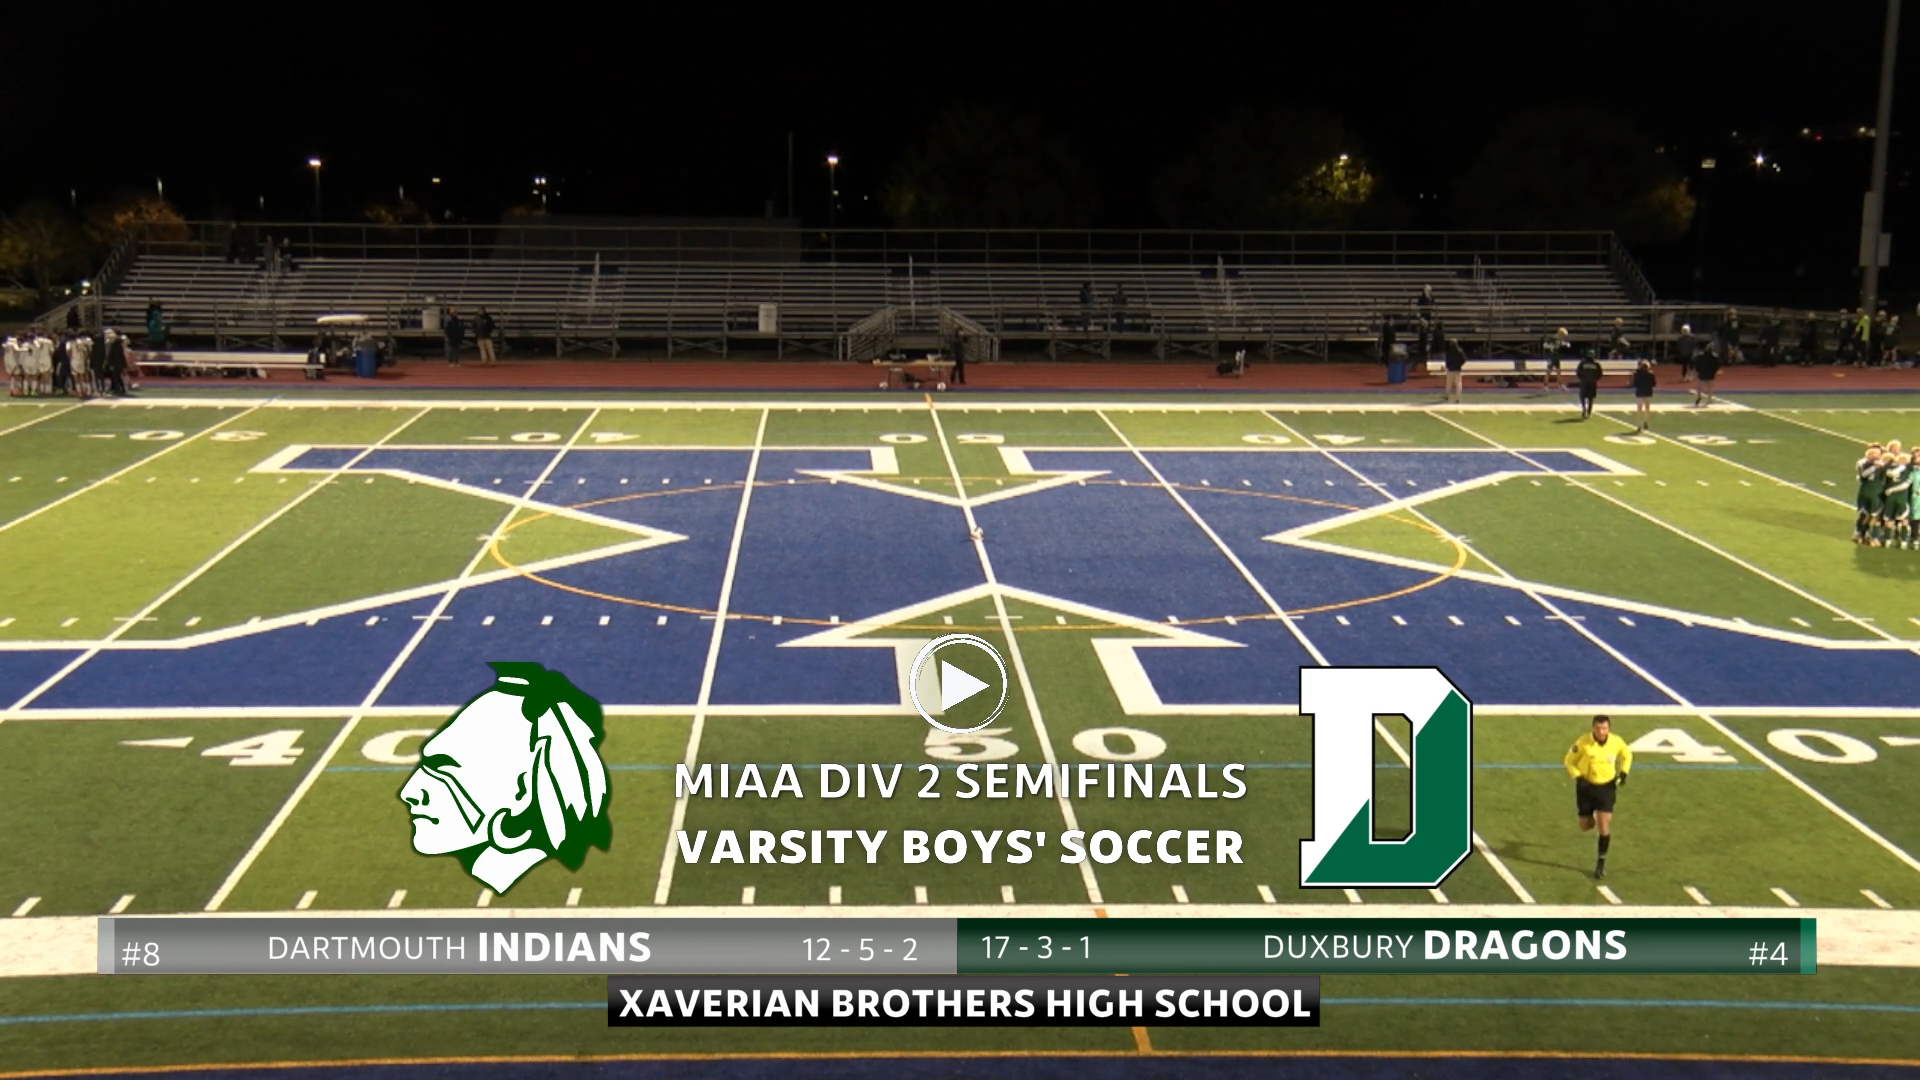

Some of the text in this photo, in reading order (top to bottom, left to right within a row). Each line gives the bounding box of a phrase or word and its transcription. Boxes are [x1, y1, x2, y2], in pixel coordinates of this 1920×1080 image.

[879, 433, 1005, 445] 50
[924, 726, 1168, 763] 50
[1628, 727, 1879, 764] 40
